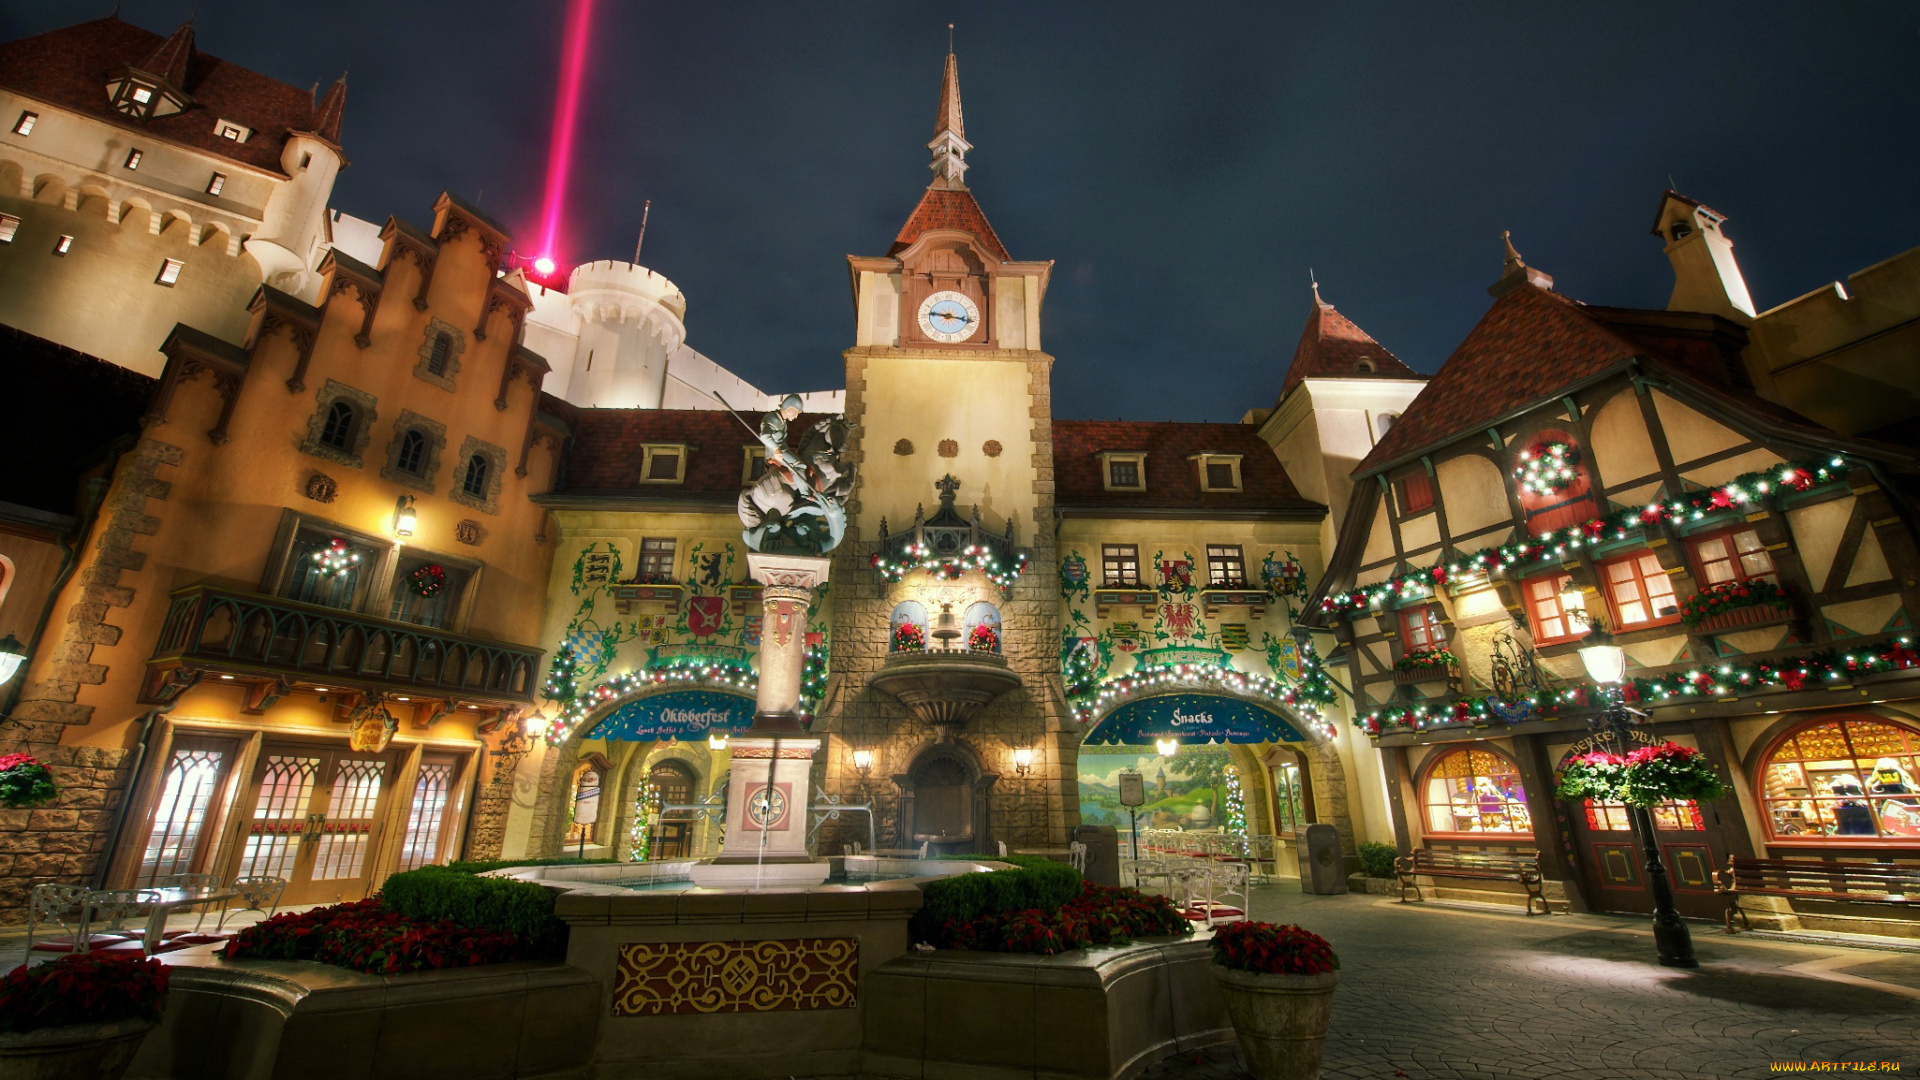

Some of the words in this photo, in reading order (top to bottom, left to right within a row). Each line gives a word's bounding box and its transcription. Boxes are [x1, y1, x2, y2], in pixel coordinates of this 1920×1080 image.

[658, 645, 744, 660] BIERGARTEN
[660, 708, 731, 732] Oktoberfest
[1170, 708, 1213, 726] Snacks
[1570, 737, 1595, 755] DER
